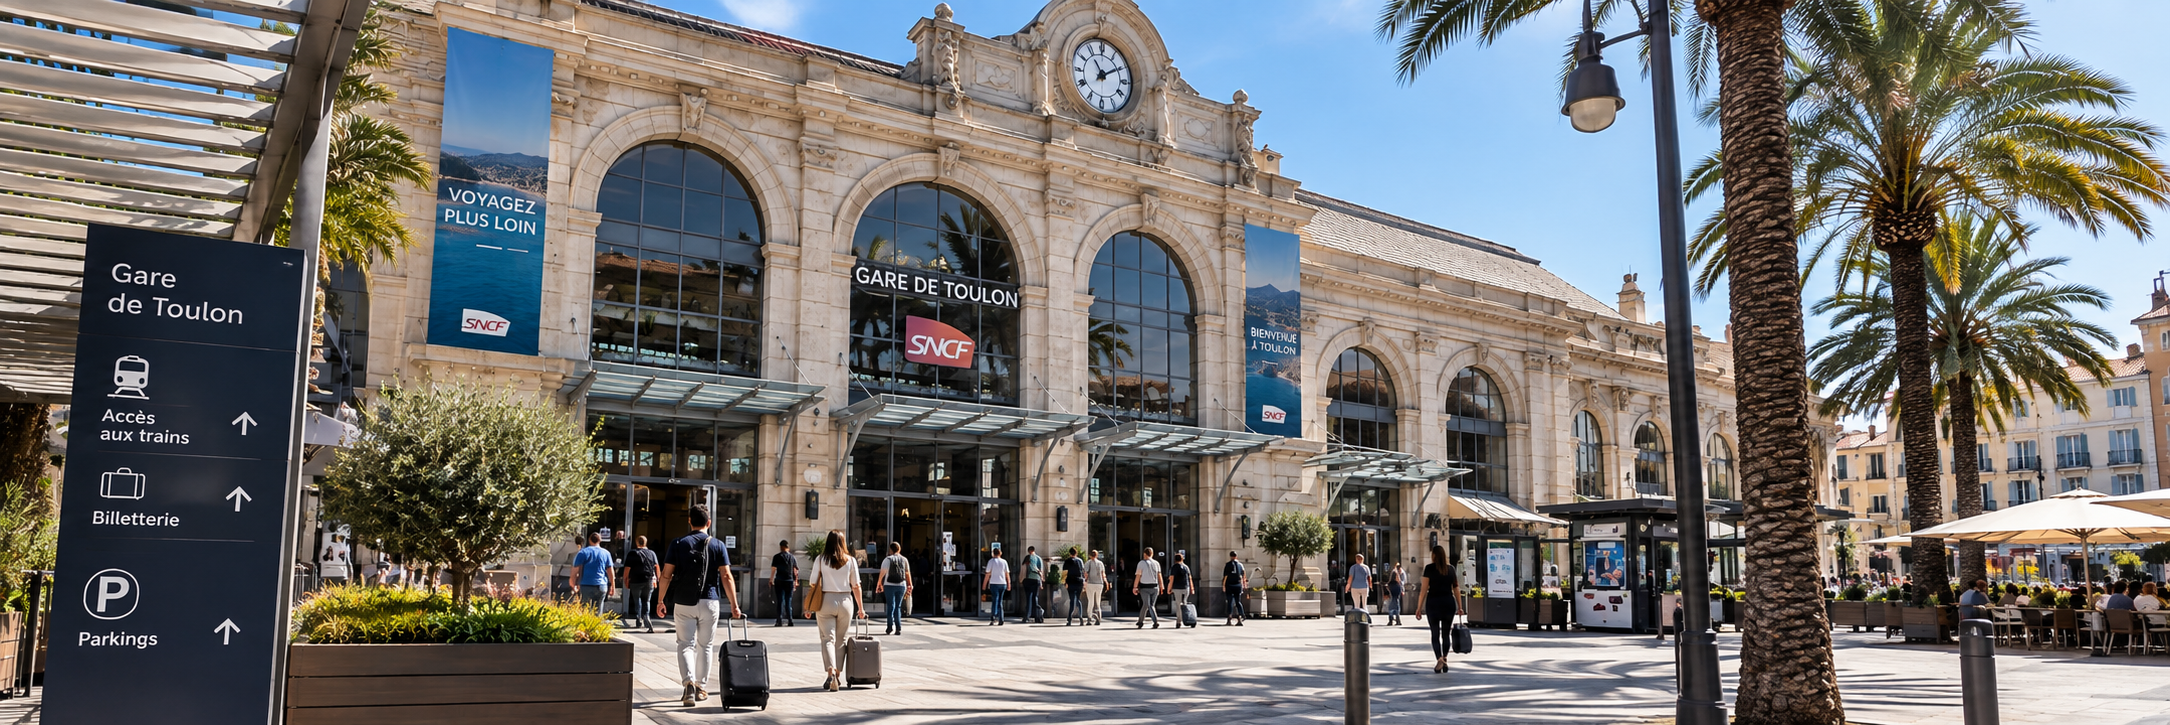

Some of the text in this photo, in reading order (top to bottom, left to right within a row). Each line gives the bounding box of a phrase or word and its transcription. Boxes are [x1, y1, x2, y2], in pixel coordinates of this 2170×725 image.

[448, 187, 537, 215] VOYAGEZ
[444, 208, 537, 236] PLUS LOIN
[111, 263, 177, 288] Gare
[855, 266, 1018, 308] GARE DE TOULON
[107, 293, 244, 325] de Toulon
[464, 318, 507, 332] SNCF
[907, 334, 973, 360] SNCF
[1259, 341, 1297, 355] TOULON
[101, 408, 156, 425] Accès
[1263, 411, 1285, 421] SNCF
[100, 429, 190, 445] aux trains
[92, 510, 180, 527] Billetterie
[78, 631, 159, 650] Parkings
